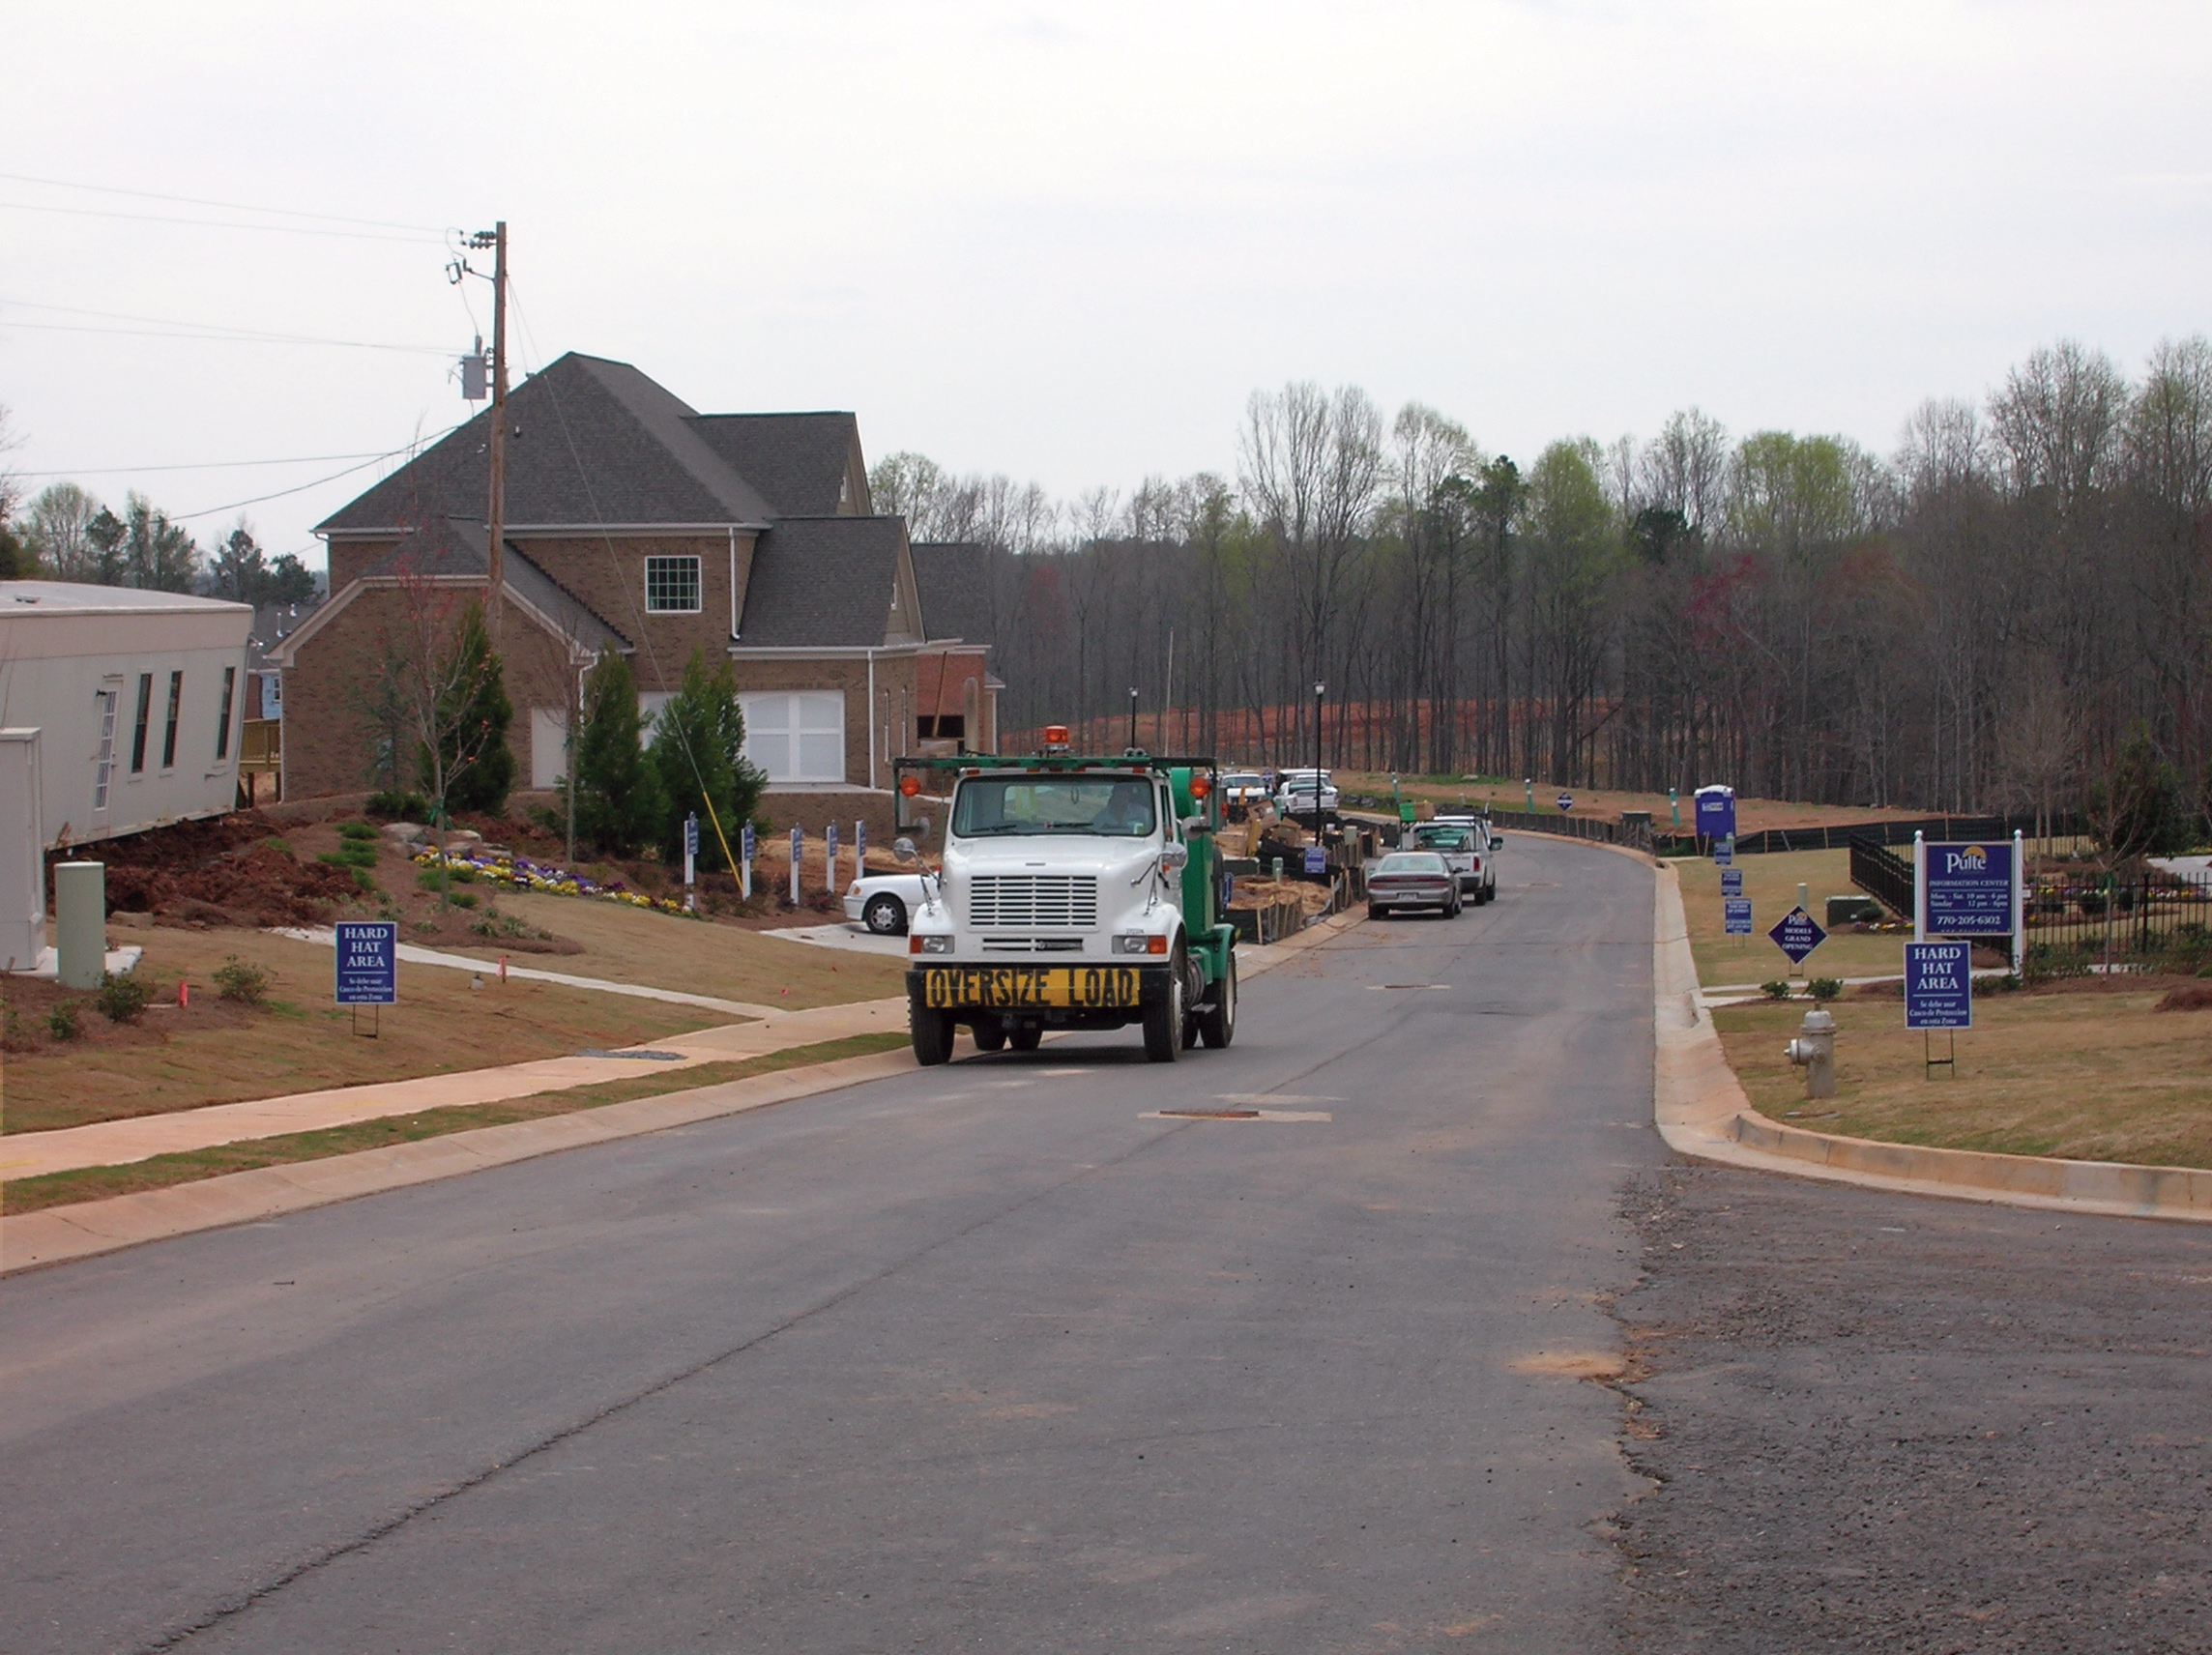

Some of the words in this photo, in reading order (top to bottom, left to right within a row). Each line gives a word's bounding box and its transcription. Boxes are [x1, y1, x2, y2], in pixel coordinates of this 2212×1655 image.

[1945, 853, 1987, 874] Pulte
[1937, 915, 2001, 925] 770-205-6302
[345, 927, 389, 939] HARD
[351, 942, 382, 953] HAT
[1914, 947, 1962, 959] HARD
[346, 956, 386, 967] AREA
[1922, 962, 1954, 974] HAT
[931, 969, 1051, 1007] OVERSIZE
[1068, 968, 1134, 1007] LOAD
[1917, 976, 1959, 990] AREA
